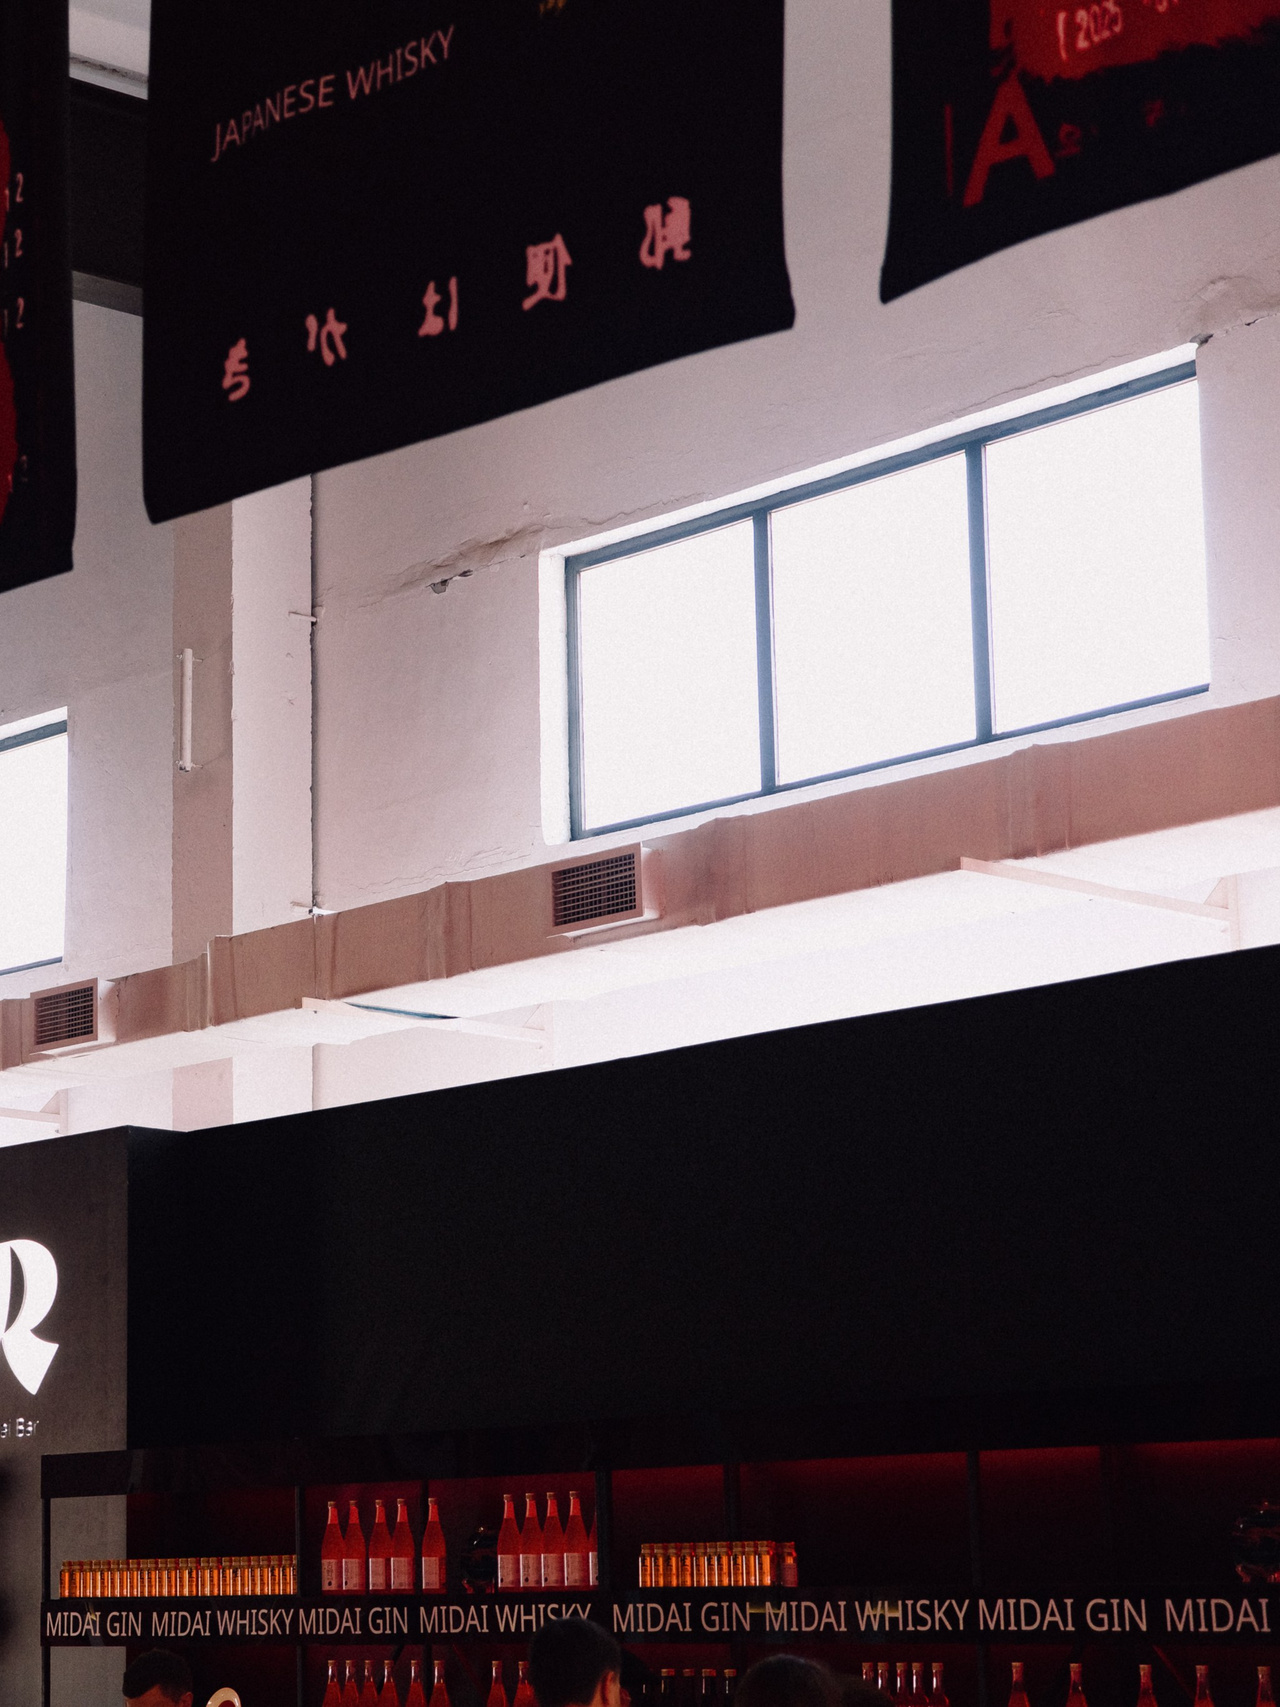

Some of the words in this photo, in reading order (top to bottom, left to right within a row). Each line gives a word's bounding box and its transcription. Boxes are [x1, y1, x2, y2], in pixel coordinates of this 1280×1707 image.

[210, 74, 337, 163] JAPANESE
[345, 24, 455, 101] WHISKY
[16, 1417, 40, 1438] Bar
[46, 1611, 101, 1637] MIDAI
[106, 1611, 142, 1637] GIN
[151, 1610, 212, 1637] MIDAI
[216, 1608, 294, 1636] WHISKY
[298, 1608, 362, 1635] MIDAI
[367, 1607, 408, 1634] GIN
[419, 1605, 489, 1633] MIDAI
[612, 1602, 692, 1633] MIDAI
[701, 1602, 756, 1632] GIN
[765, 1601, 847, 1632] MIDAI
[854, 1599, 970, 1632] WHISKY
[978, 1598, 1075, 1631] MIDAI
[1086, 1597, 1148, 1632] GIN
[1165, 1598, 1271, 1632] MIDAI
